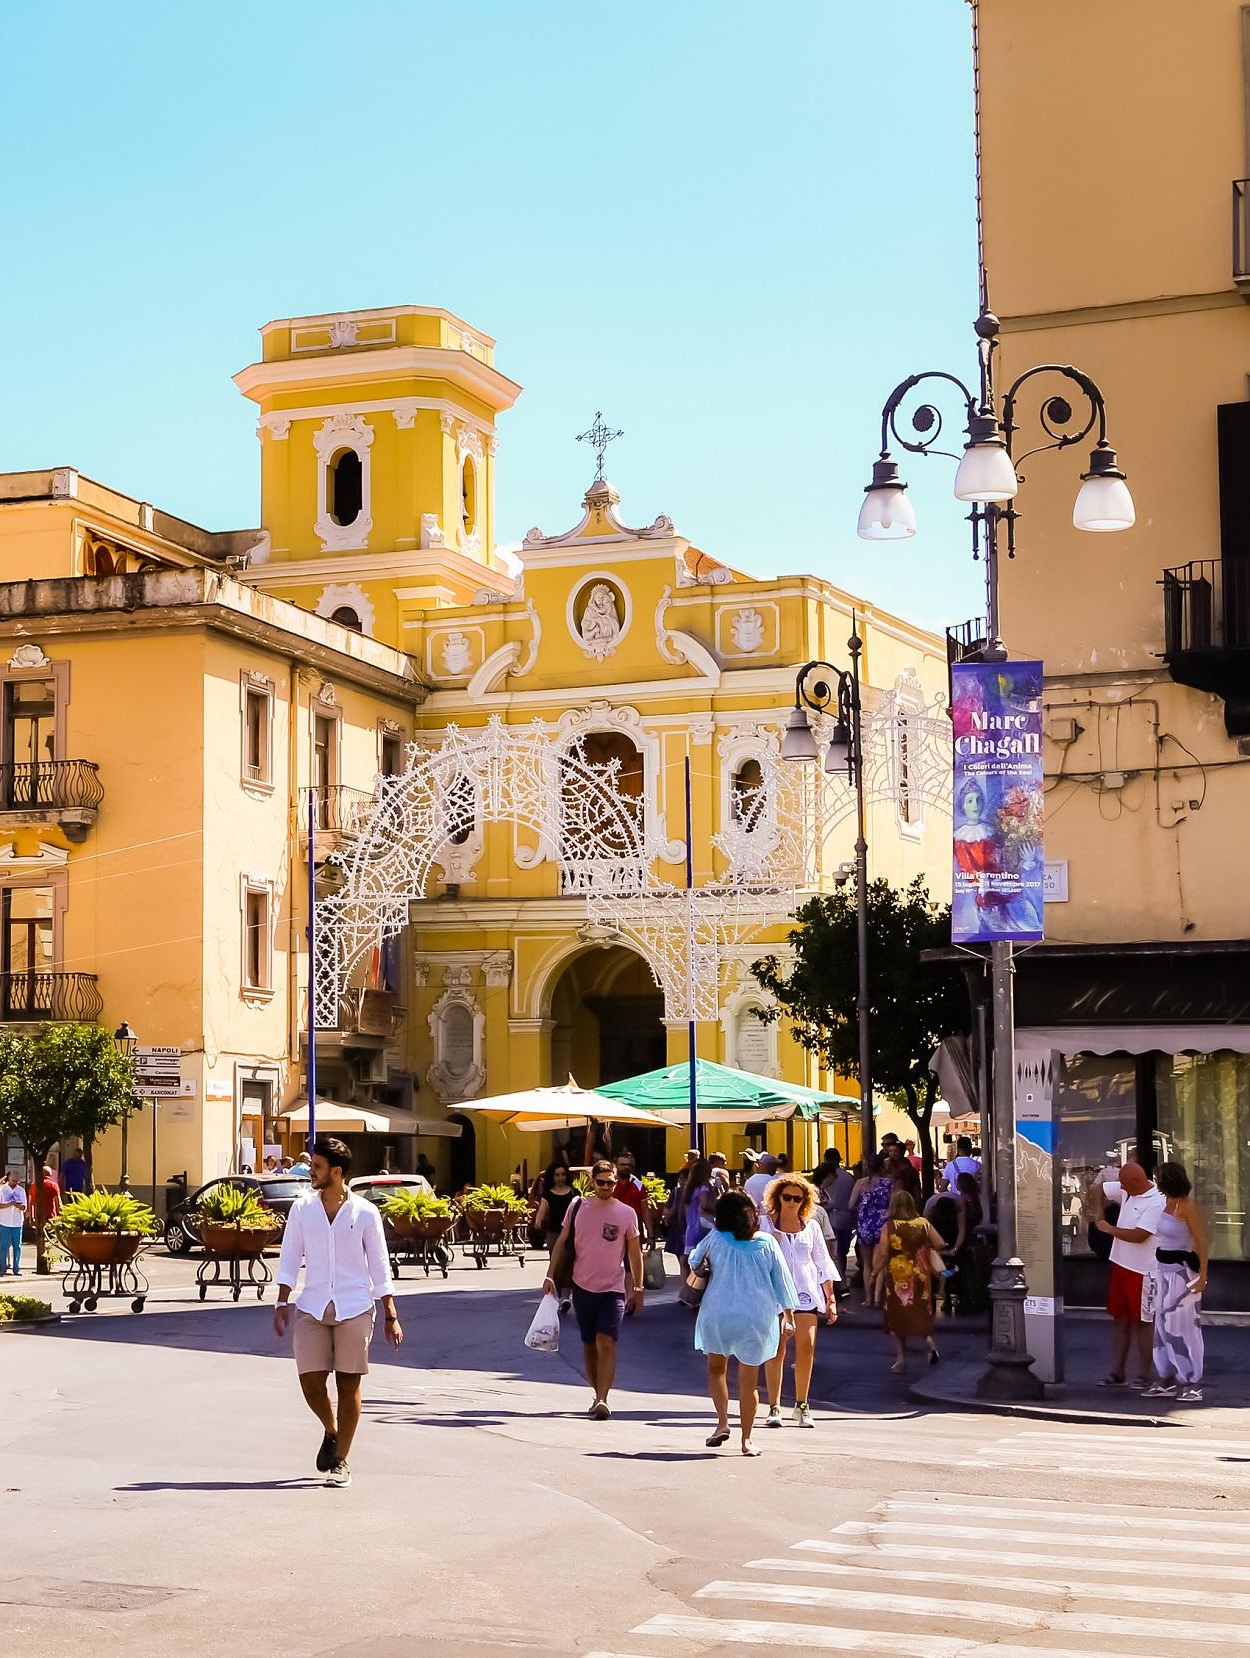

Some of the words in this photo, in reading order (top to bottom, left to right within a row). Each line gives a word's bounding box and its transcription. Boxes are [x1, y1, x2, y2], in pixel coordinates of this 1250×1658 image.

[970, 711, 1028, 730] Marc
[955, 732, 1040, 759] Chagall
[955, 872, 975, 880] Villa
